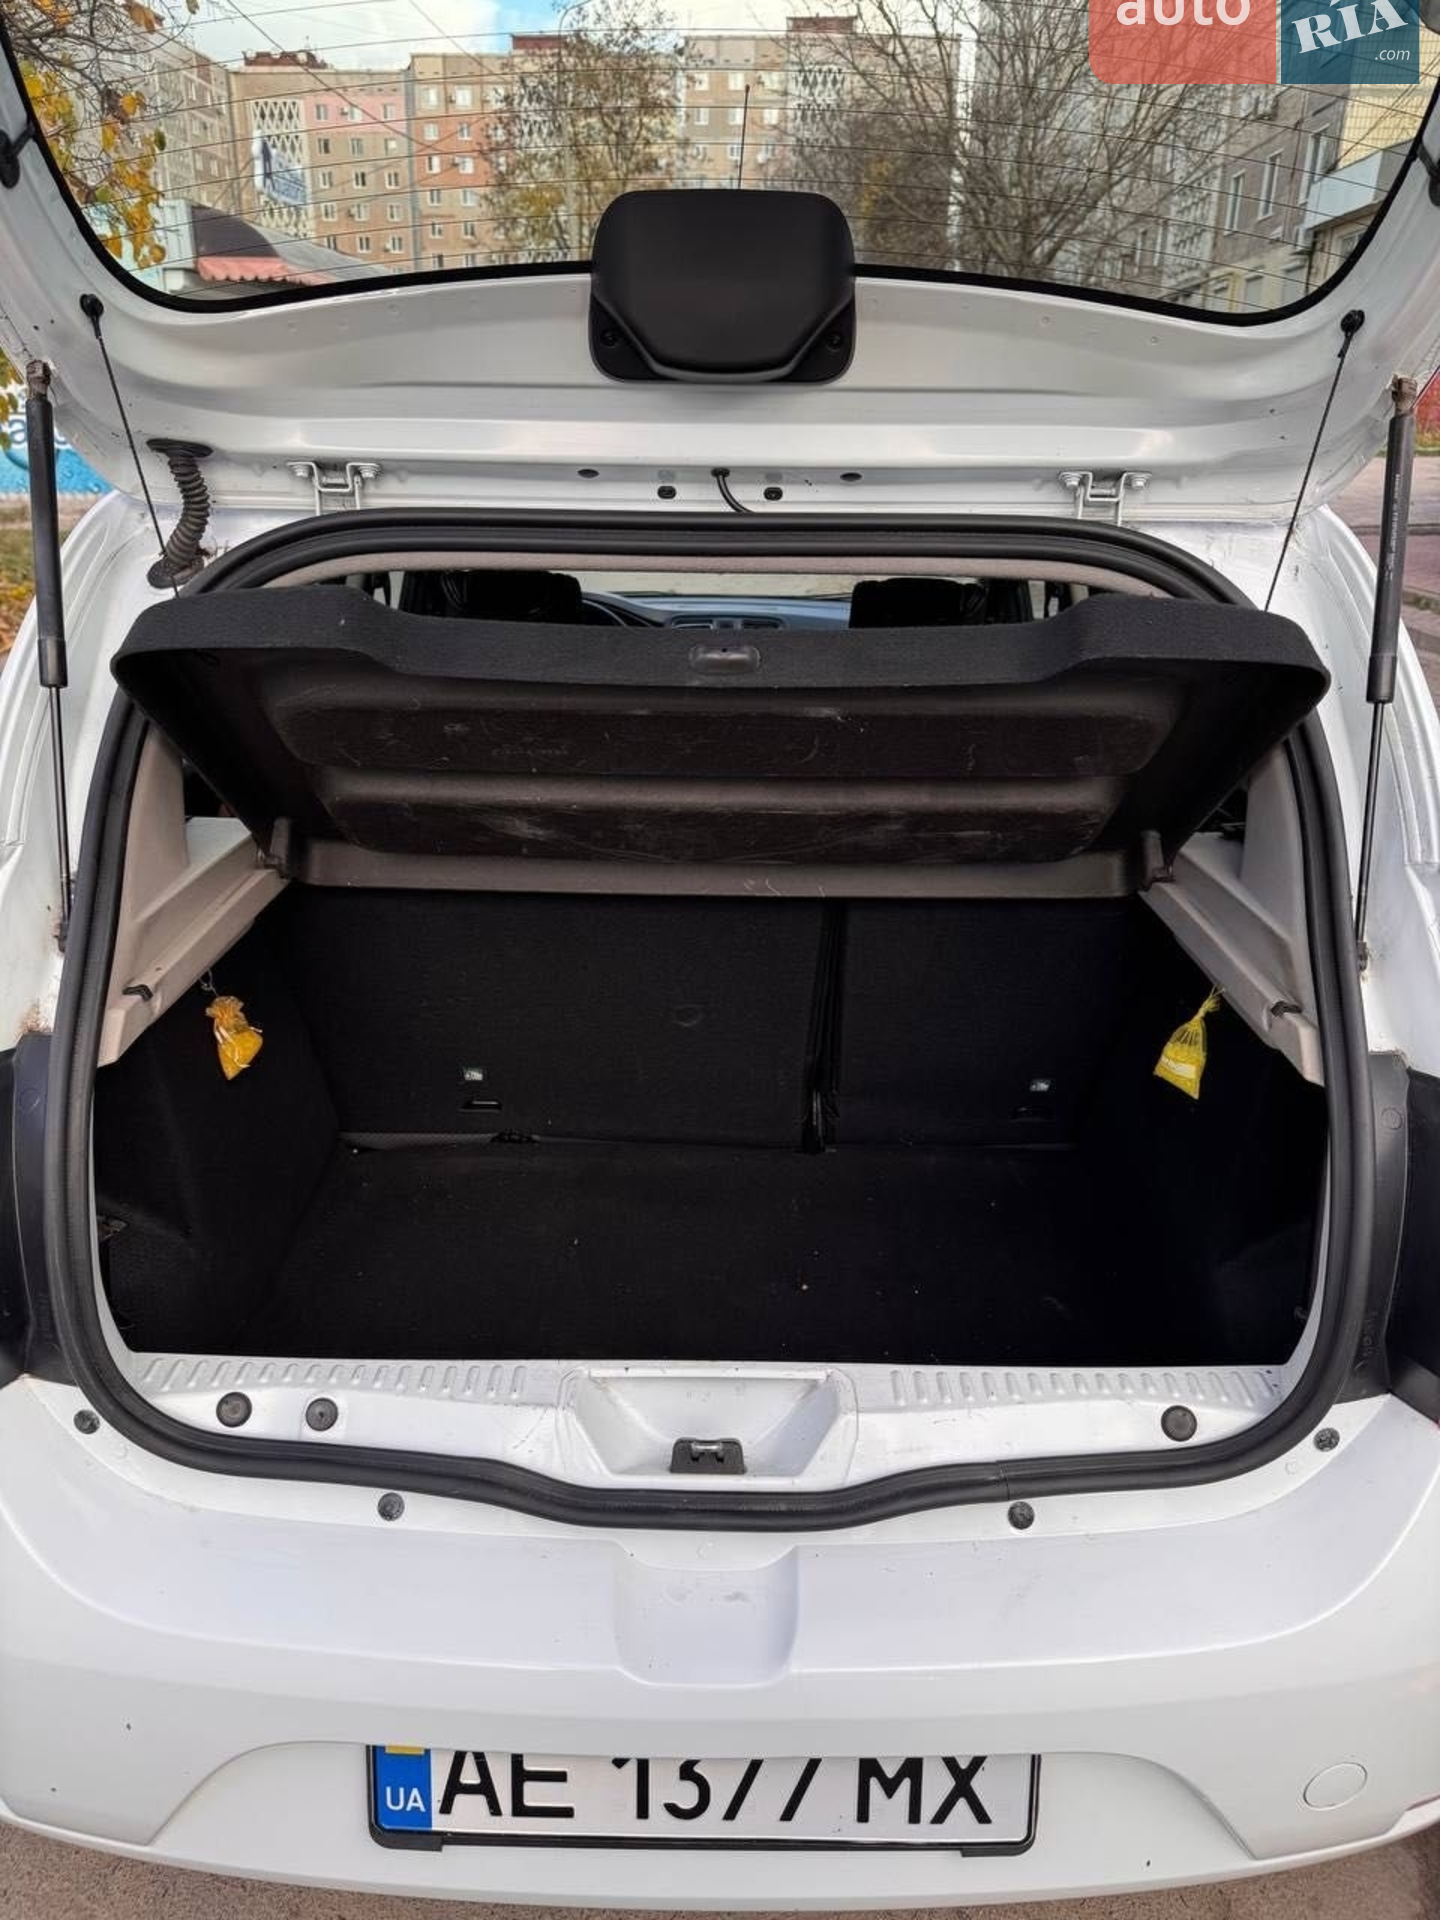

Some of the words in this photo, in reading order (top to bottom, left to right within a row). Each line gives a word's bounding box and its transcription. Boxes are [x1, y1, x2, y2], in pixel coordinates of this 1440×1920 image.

[385, 1786, 427, 1812] UA
[438, 1750, 575, 1818] AE
[856, 1755, 993, 1825] MX
